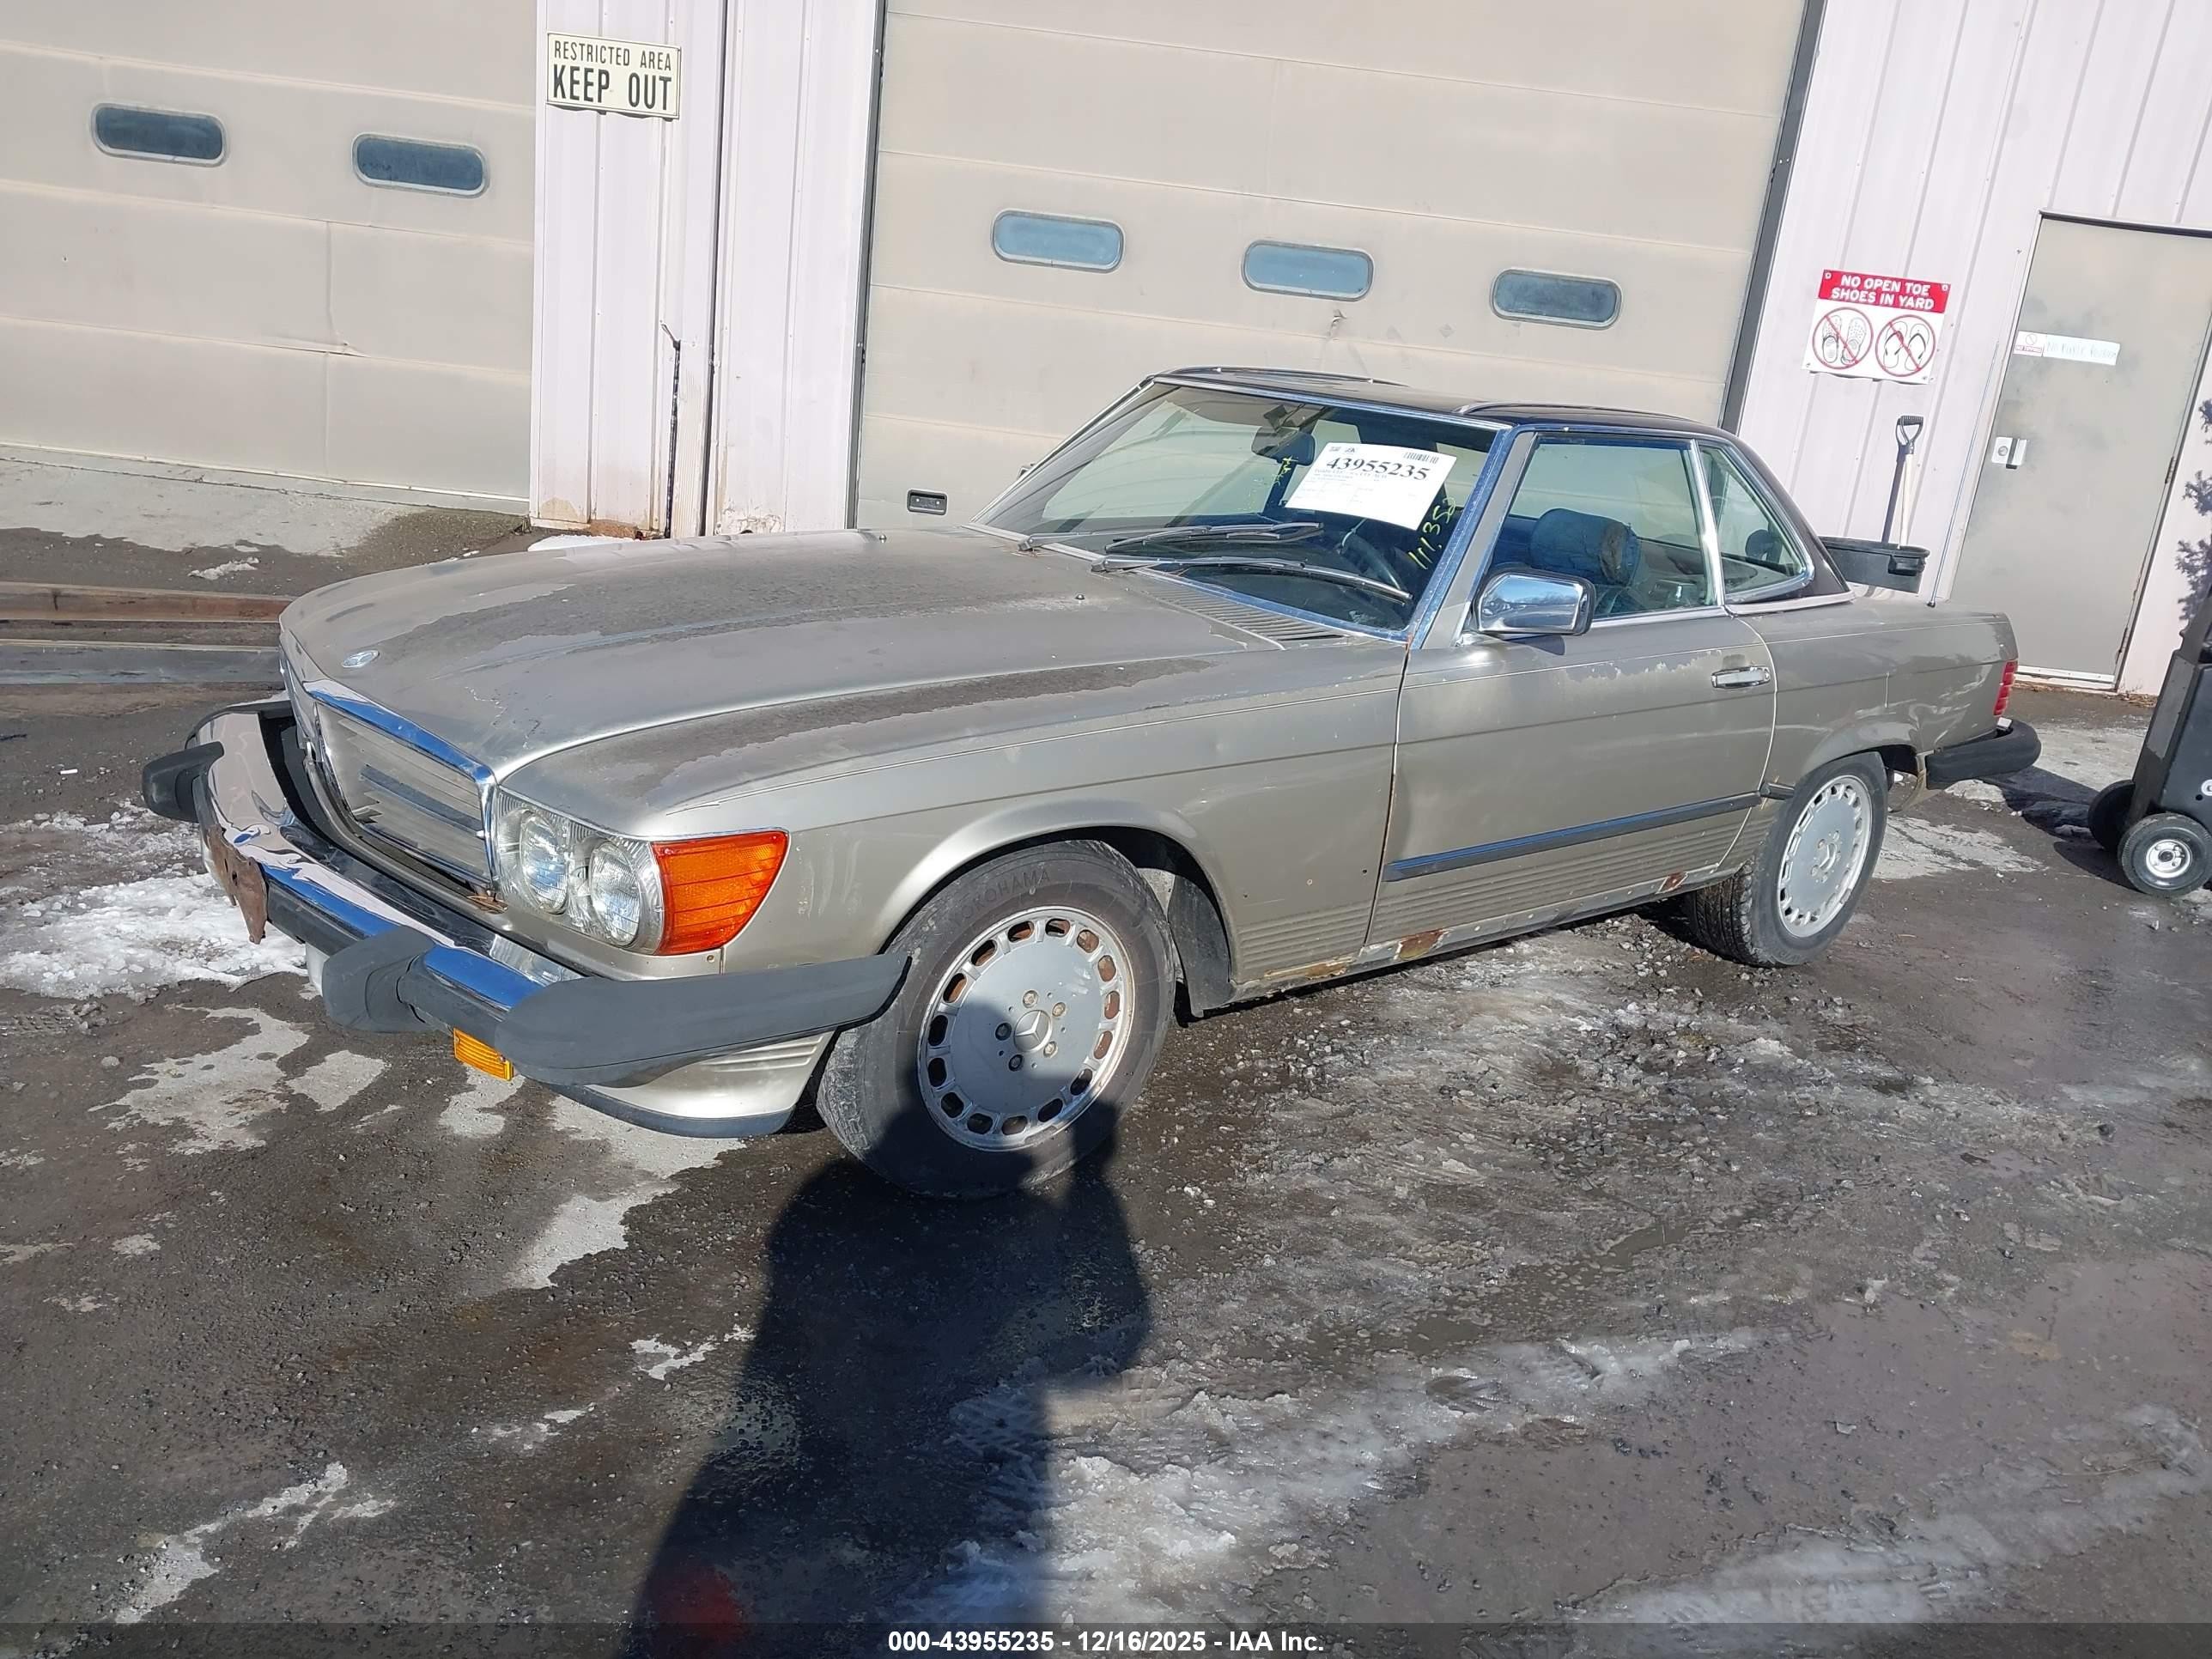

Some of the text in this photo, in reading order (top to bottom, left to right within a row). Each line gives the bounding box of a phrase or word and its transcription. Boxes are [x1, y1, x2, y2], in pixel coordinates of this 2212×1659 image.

[555, 40, 672, 71] RESTRICTED AREA
[553, 64, 672, 111] KEEP OUT
[1841, 274, 1931, 296] NO OPEN TOE
[1832, 287, 1934, 310] SHOES IN YARD
[1327, 456, 1431, 481] 43955235
